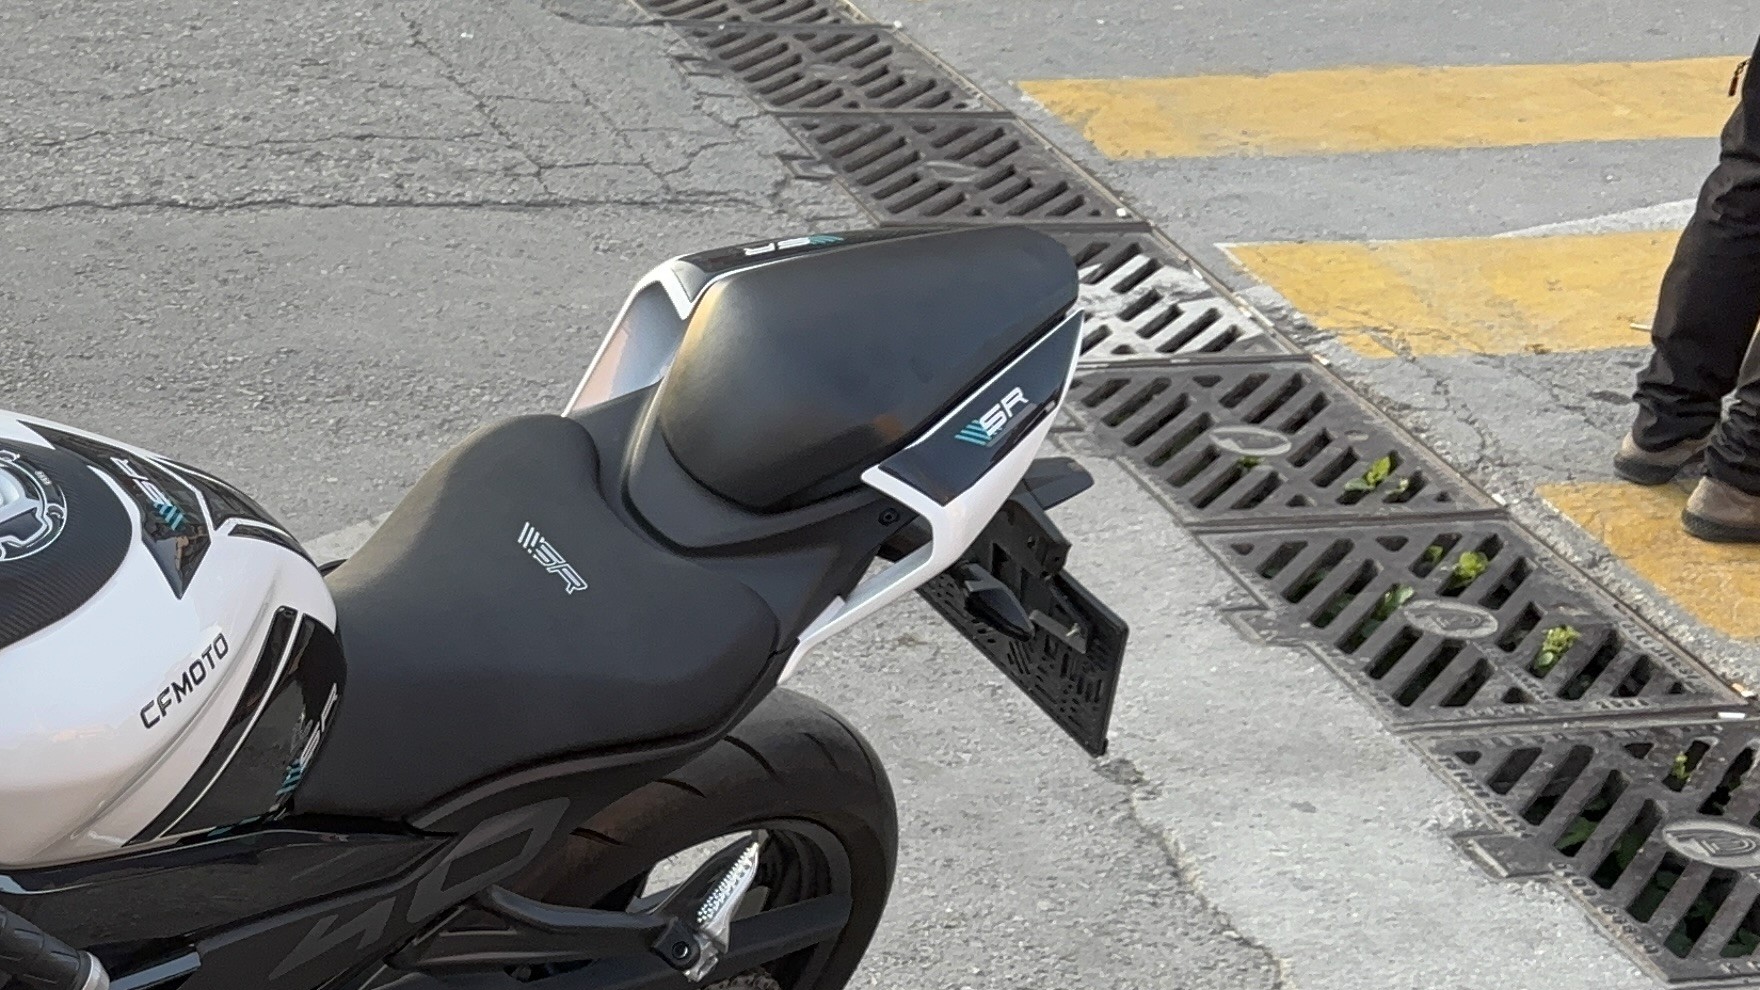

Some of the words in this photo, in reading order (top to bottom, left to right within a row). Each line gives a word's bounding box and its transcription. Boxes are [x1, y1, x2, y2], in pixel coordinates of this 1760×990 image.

[979, 386, 1030, 437] SR
[532, 536, 589, 595] SR
[140, 632, 229, 730] CFMOTO
